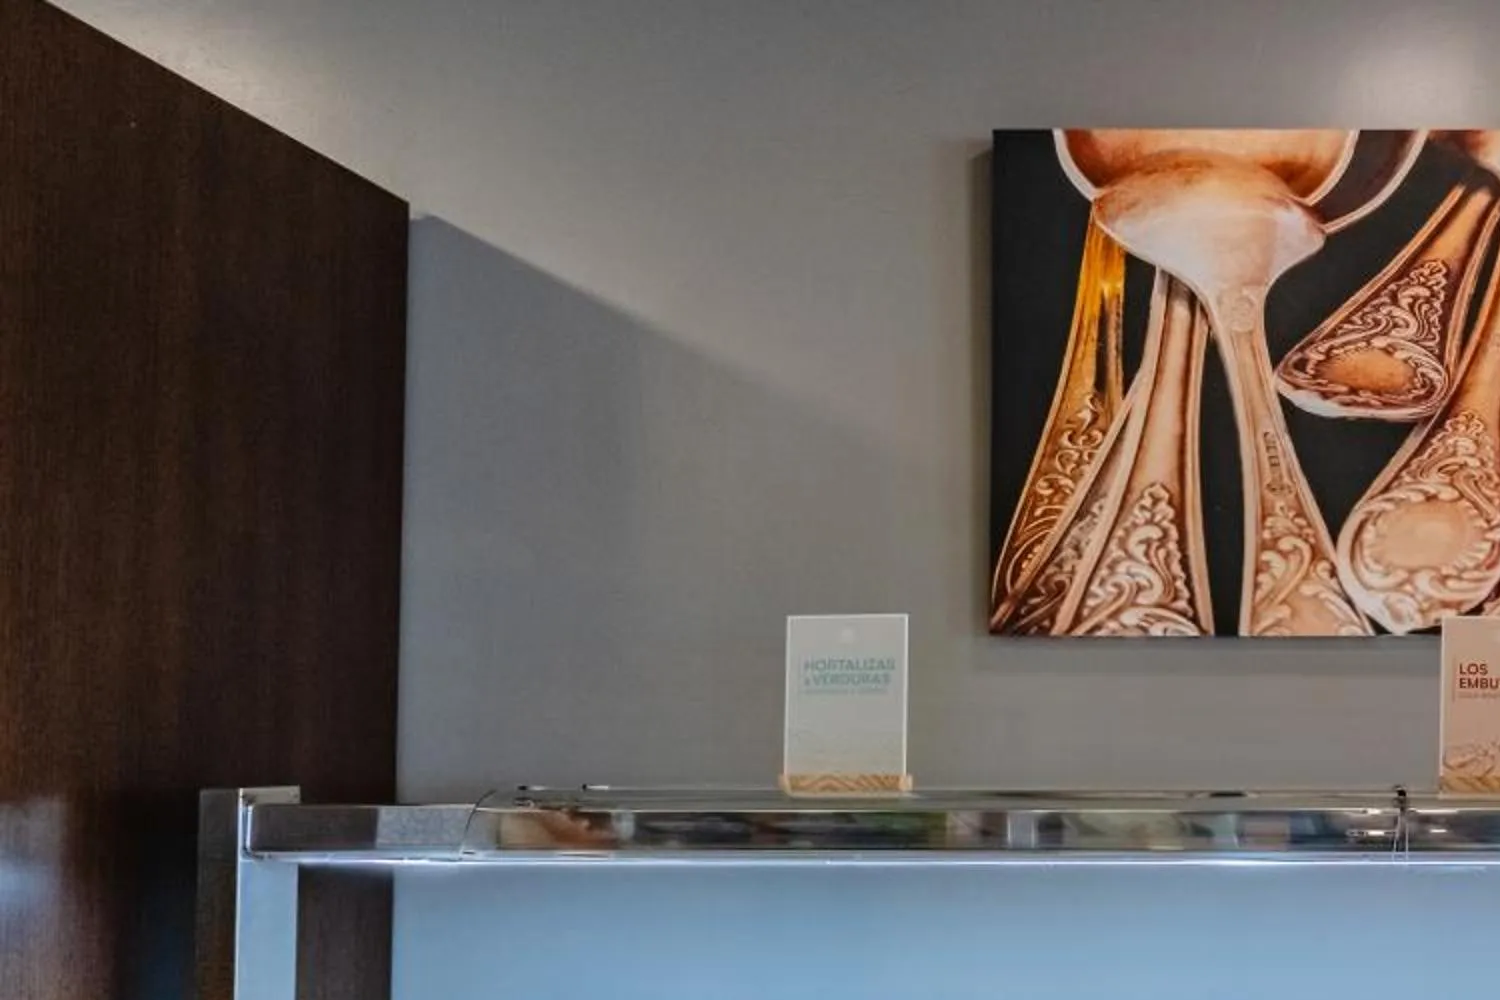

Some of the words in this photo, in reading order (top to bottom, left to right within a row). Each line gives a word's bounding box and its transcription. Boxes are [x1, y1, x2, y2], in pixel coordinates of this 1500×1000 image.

[804, 657, 896, 671] HORTALIZAS
[1459, 663, 1488, 676] LOS
[813, 673, 892, 687] VERDURAS
